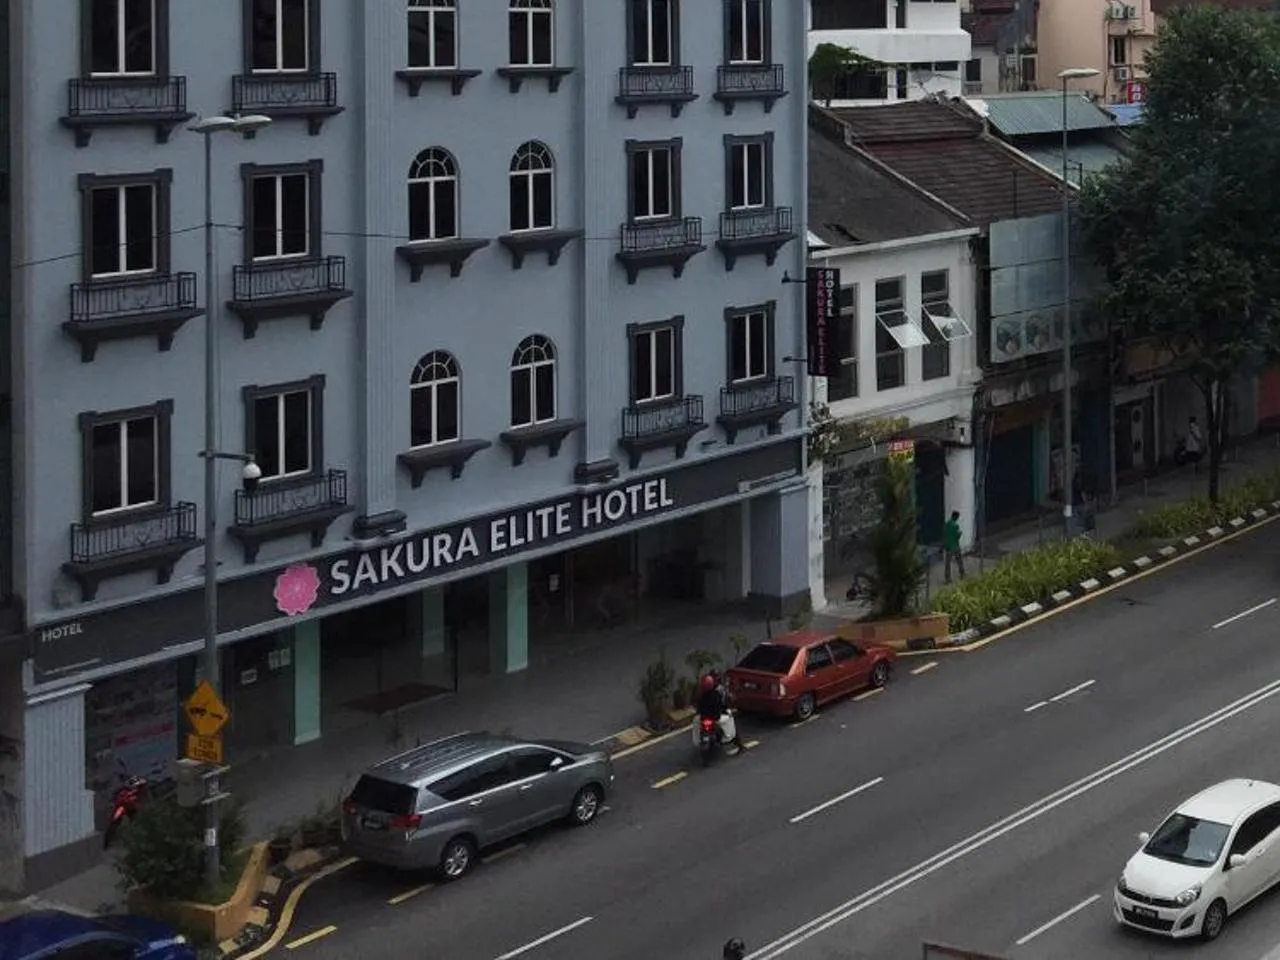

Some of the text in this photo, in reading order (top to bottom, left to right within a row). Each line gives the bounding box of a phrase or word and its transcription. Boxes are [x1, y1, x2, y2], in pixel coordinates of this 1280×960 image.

[825, 270, 835, 318] HOTEL
[329, 478, 674, 595] SAKURA ELITE HOTEL
[41, 623, 83, 642] HOTEL
